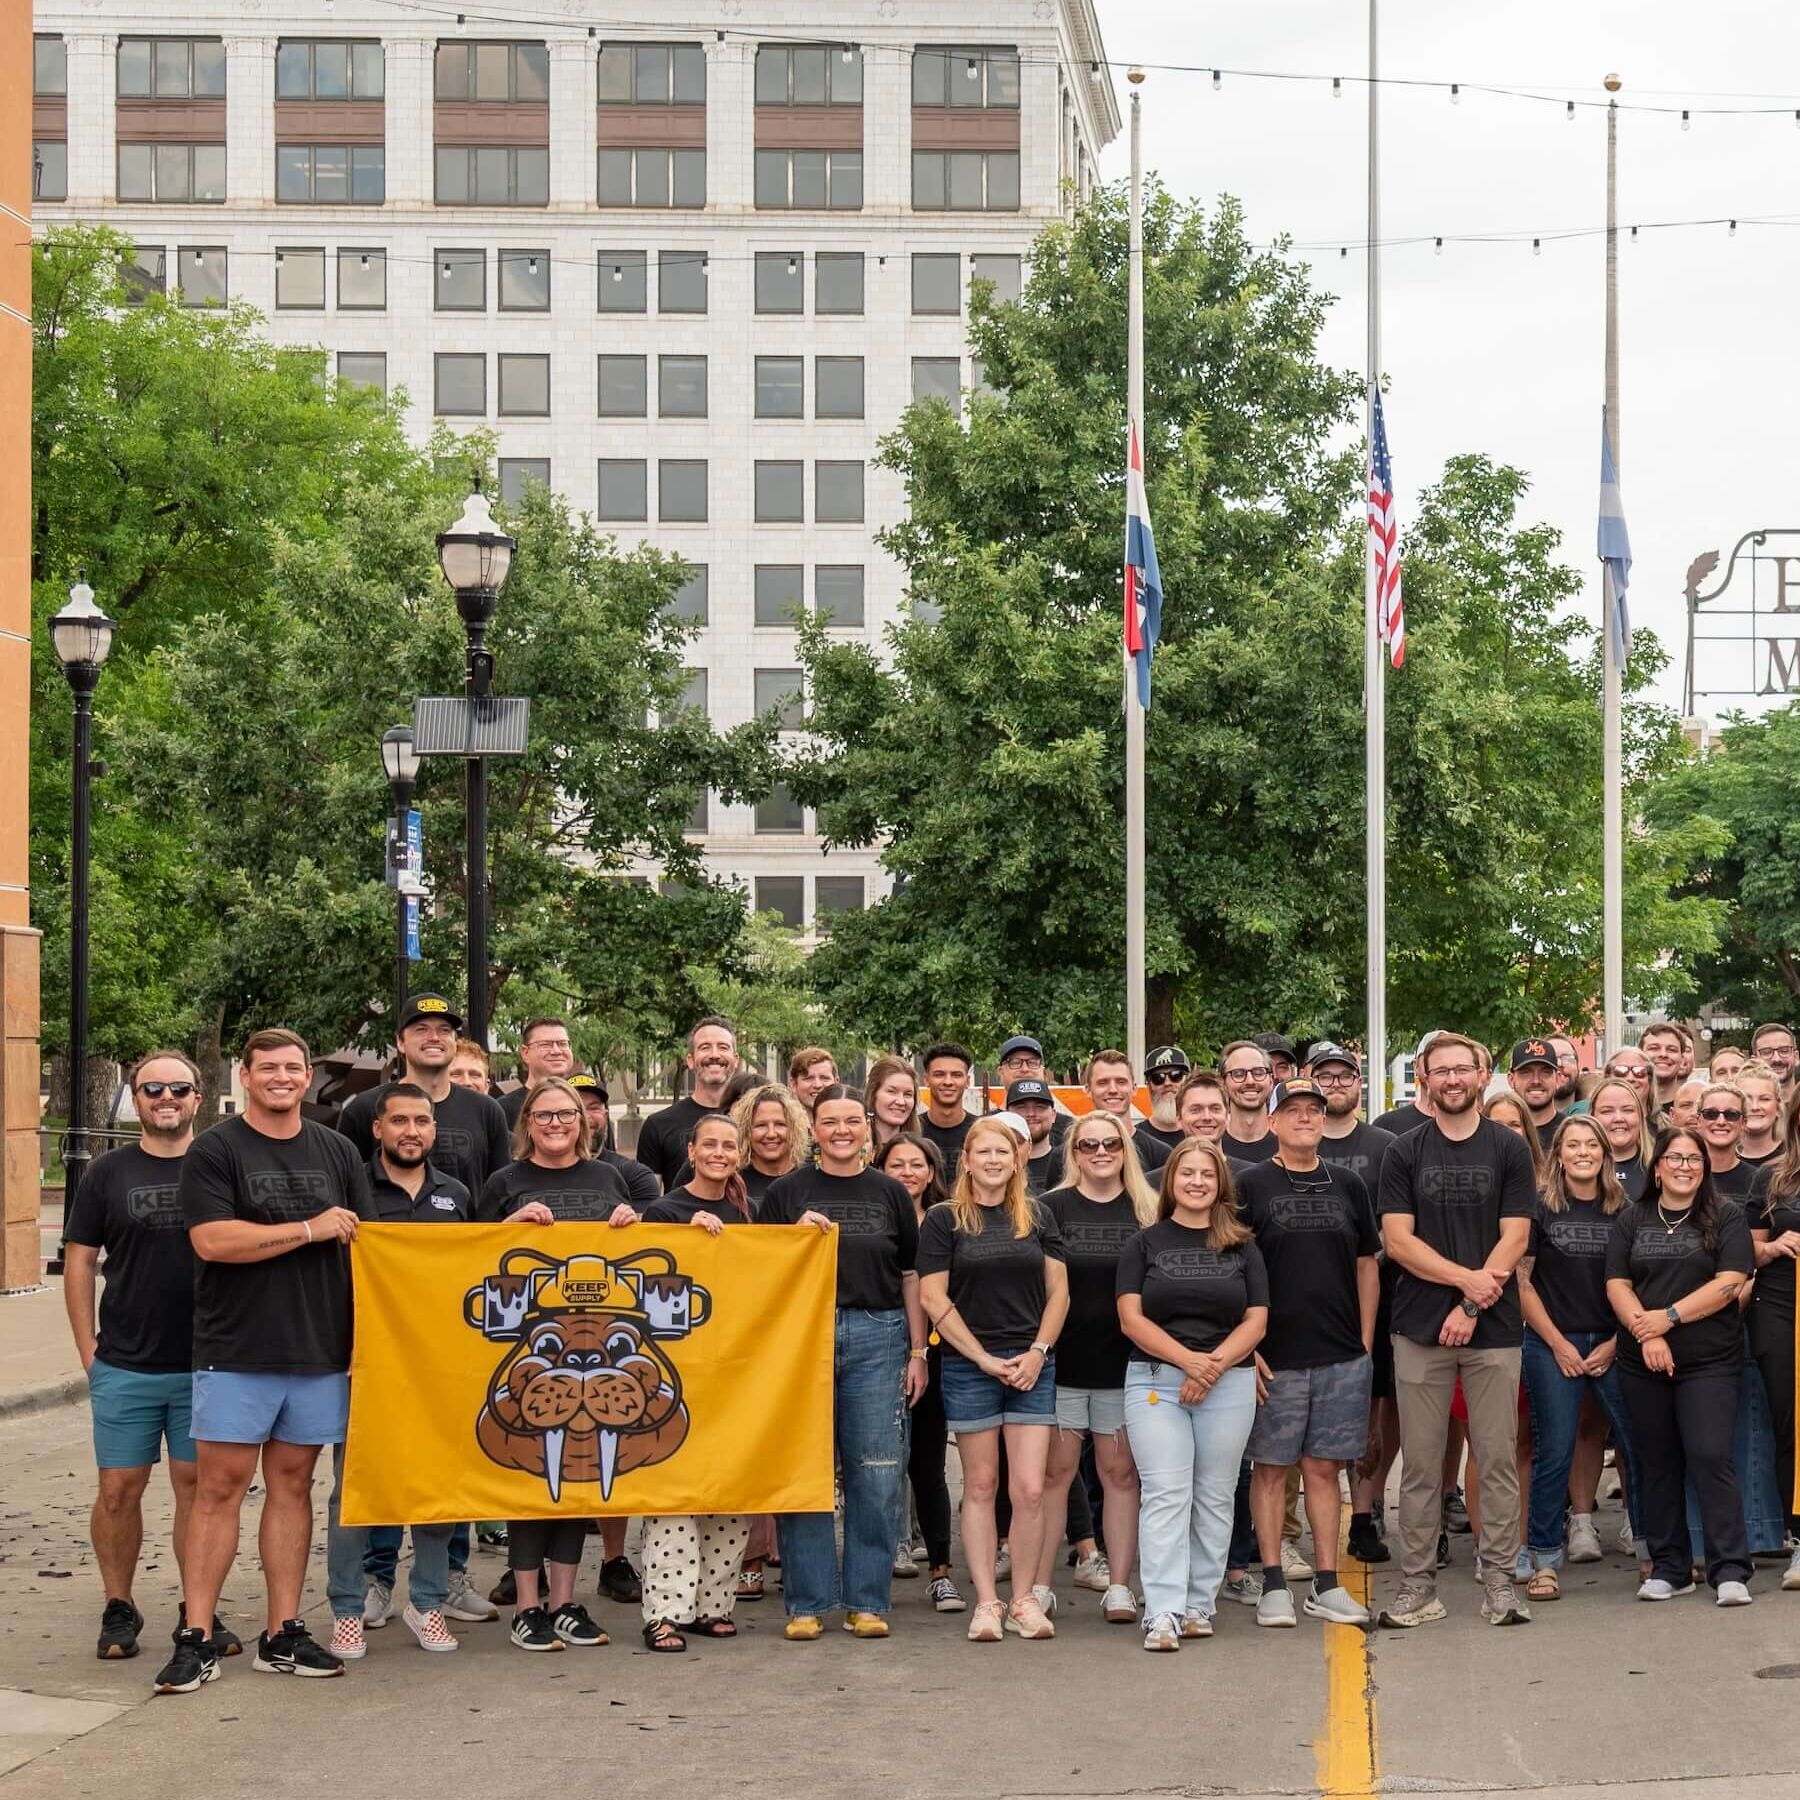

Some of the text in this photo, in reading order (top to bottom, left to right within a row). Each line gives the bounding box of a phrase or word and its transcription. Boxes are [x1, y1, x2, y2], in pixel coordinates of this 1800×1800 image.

[251, 1176, 326, 1195] KEEP
[1424, 1171, 1490, 1188] KEEP
[1275, 1200, 1342, 1214] KEEP
[1289, 1217, 1336, 1228] SUPPLY
[1162, 1251, 1233, 1266] KEEP
[1173, 1267, 1223, 1277] SUPPLY
[565, 1282, 607, 1292] KEEP
[570, 1294, 601, 1302] SUPPLY
